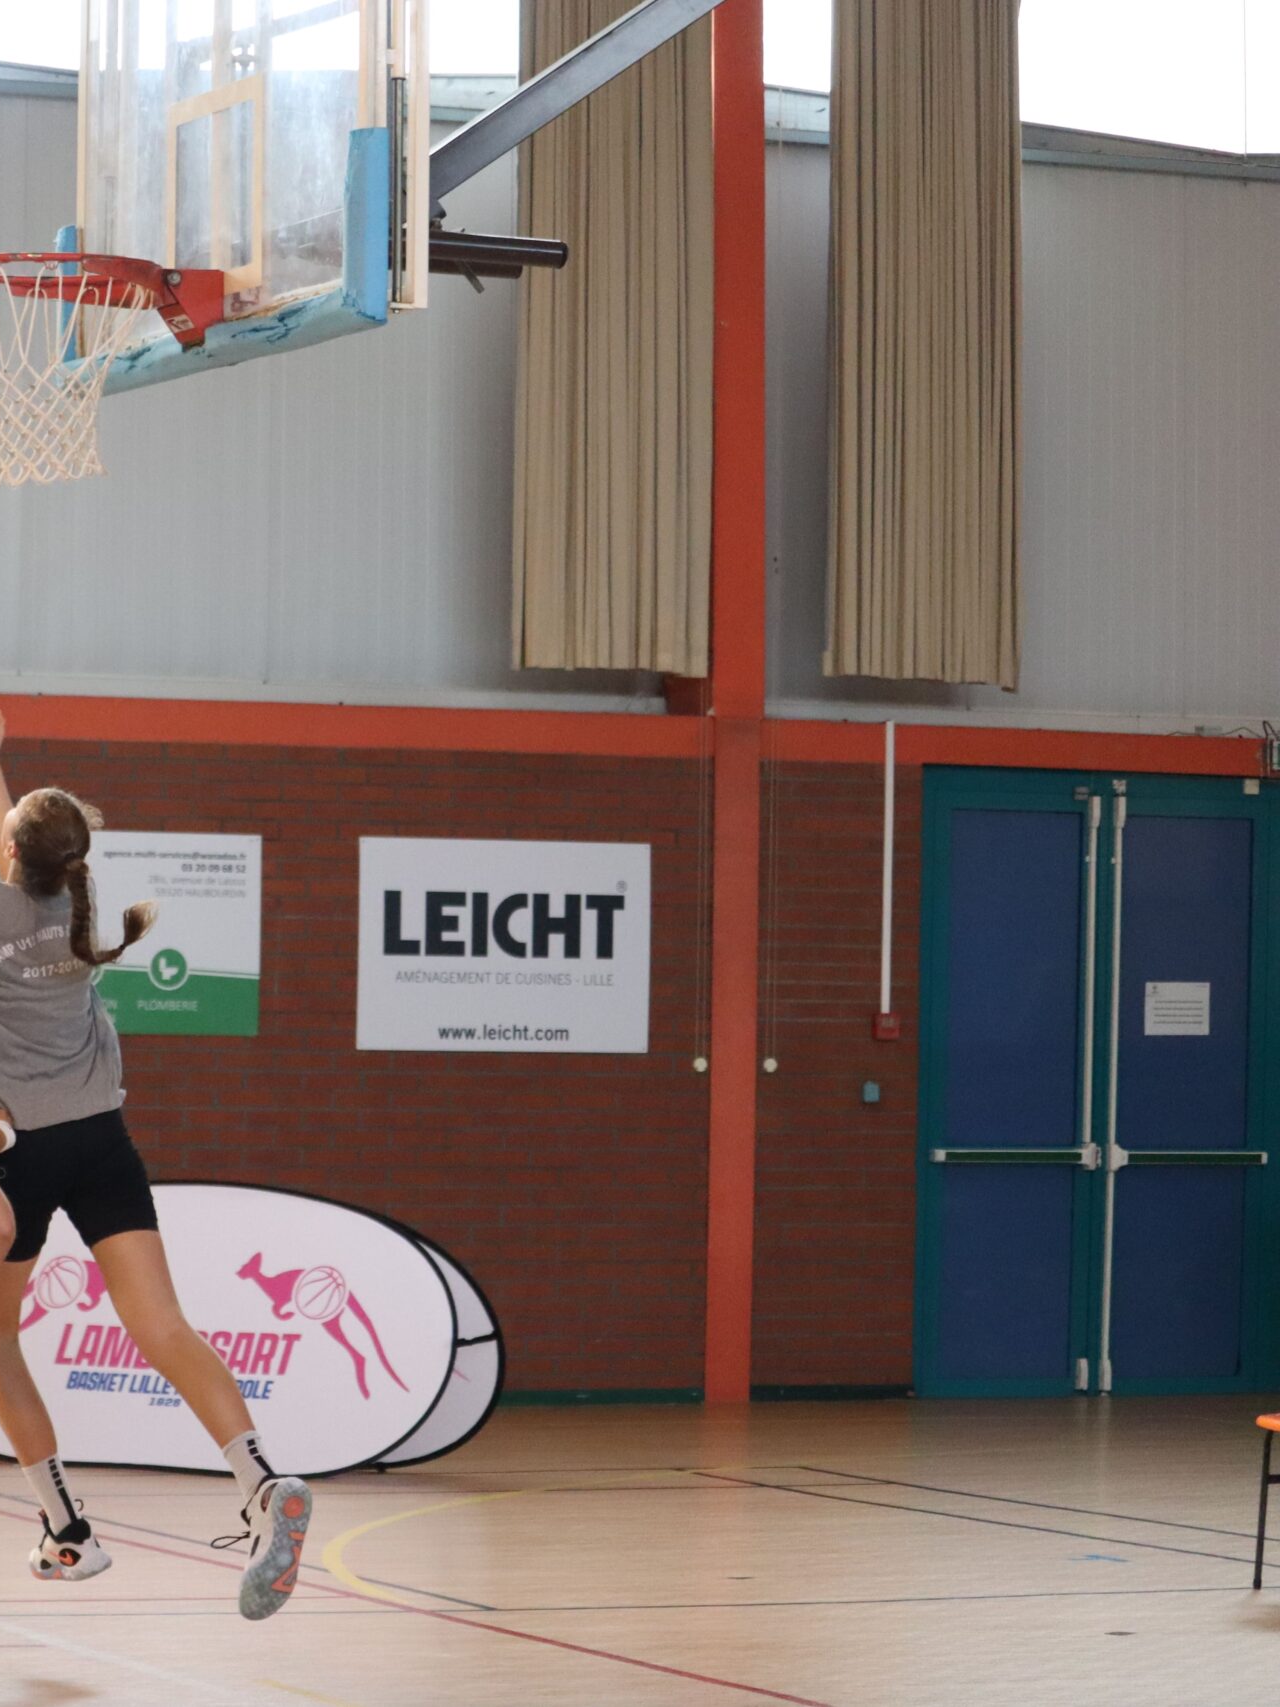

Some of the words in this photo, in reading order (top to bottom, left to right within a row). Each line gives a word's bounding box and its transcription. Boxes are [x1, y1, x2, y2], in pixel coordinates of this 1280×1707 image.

[181, 863, 193, 872] 03
[195, 864, 207, 872] 20
[222, 864, 234, 873] 68
[235, 865, 246, 873] 52
[384, 890, 625, 960] LEICHT
[395, 967, 493, 985] AMÉNAGEMENT
[496, 972, 511, 985] DE
[516, 972, 572, 987] CUISINES
[584, 973, 614, 987] LILLE
[137, 1000, 198, 1011] PLOMBERIE
[438, 1024, 569, 1041] www.leicht.com
[66, 1371, 128, 1393] BASKET
[129, 1375, 171, 1395] LILLE
